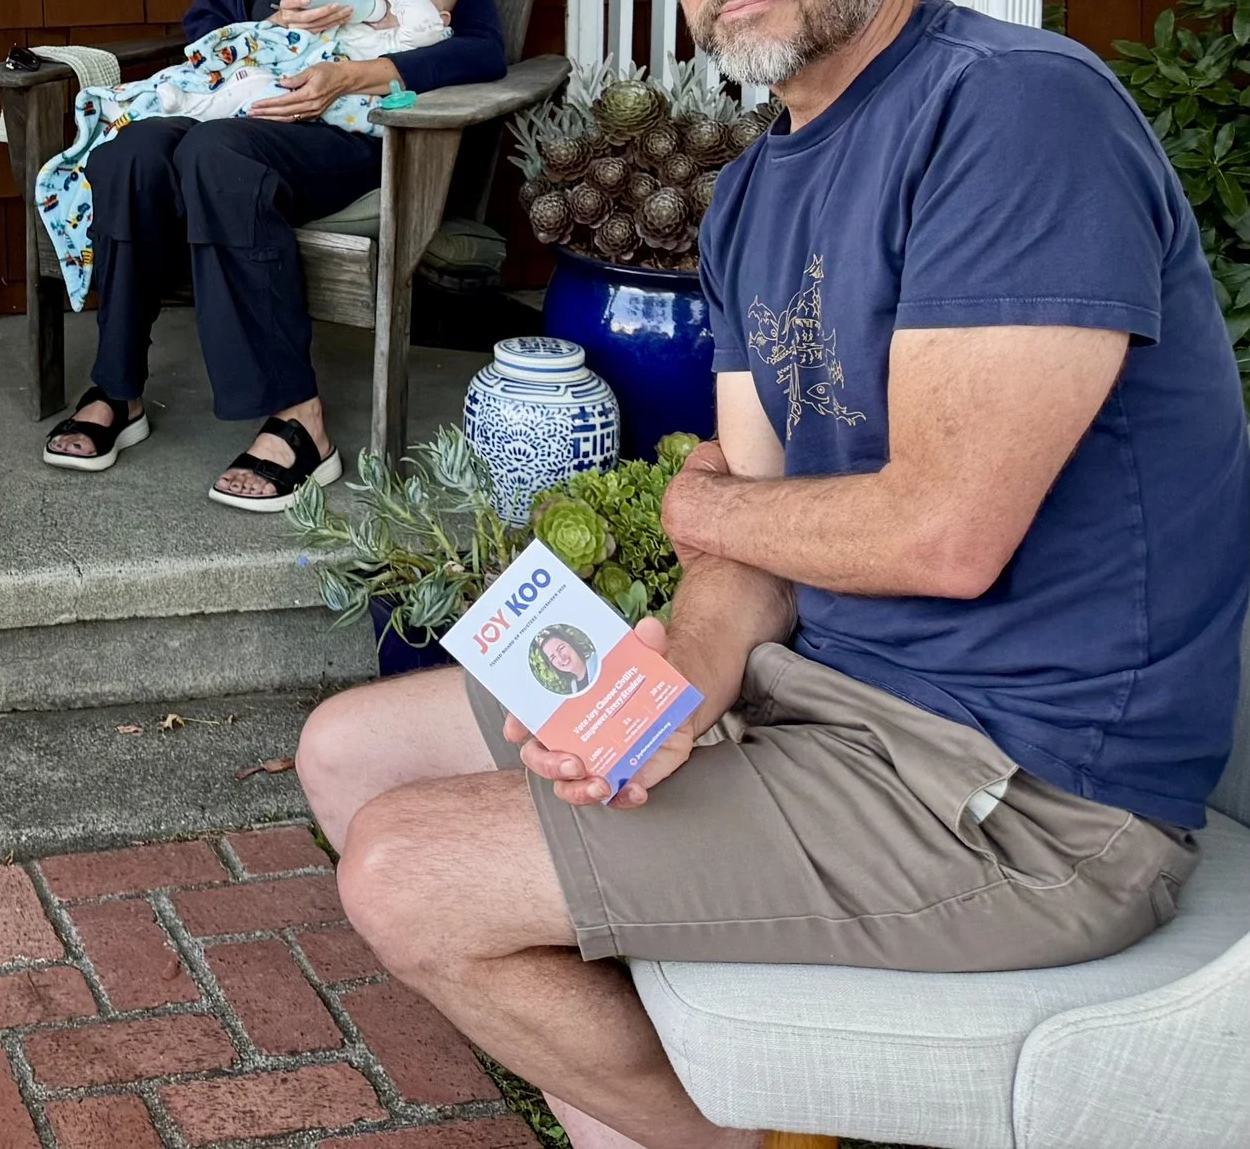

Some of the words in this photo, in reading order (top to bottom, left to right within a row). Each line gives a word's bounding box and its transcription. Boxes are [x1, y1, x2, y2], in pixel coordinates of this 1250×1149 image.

[472, 608, 510, 655] JOY
[504, 567, 551, 617] KOO
[574, 719, 588, 734] Vote
[596, 688, 617, 710] Choose
[581, 713, 608, 742] Empower
[606, 696, 624, 714] Every
[621, 673, 645, 698] Student.
